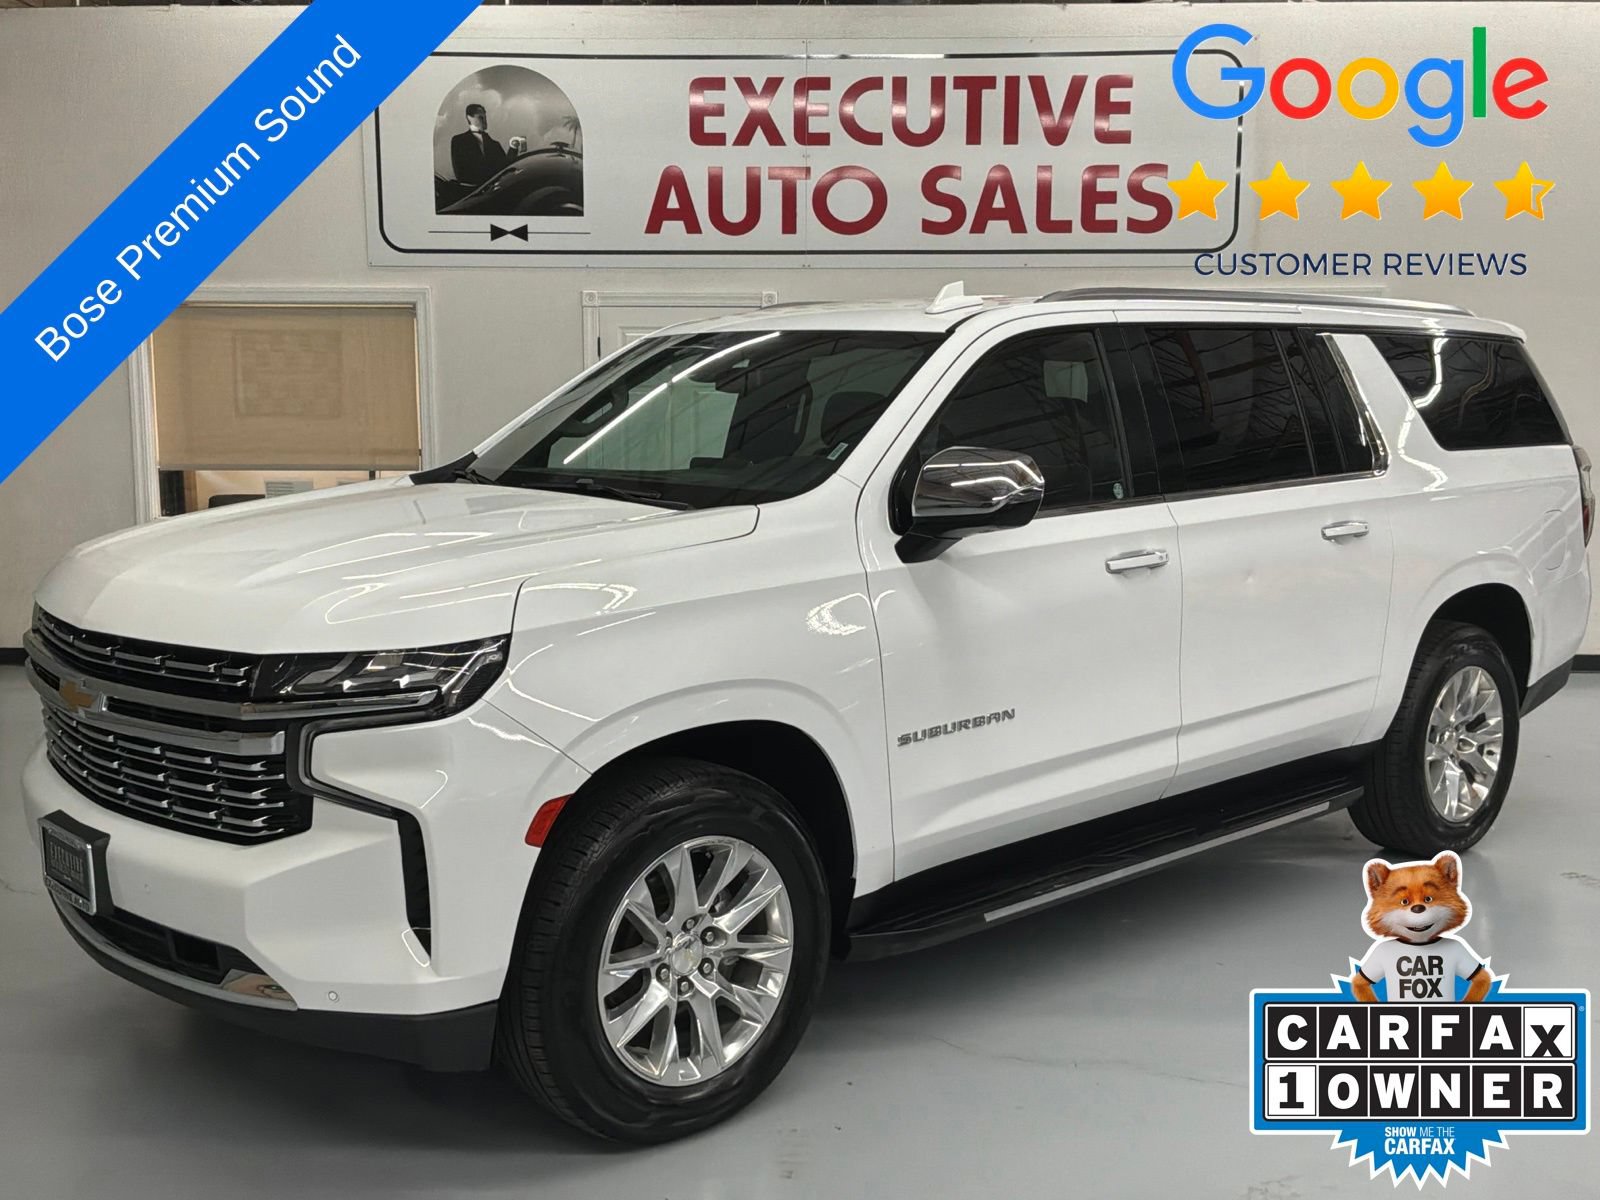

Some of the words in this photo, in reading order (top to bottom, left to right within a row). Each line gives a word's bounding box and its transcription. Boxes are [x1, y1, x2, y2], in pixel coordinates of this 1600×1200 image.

[689, 74, 1134, 147] EXECUTIVE
[645, 165, 888, 236] AUTO
[921, 163, 1173, 235] SALES
[897, 708, 1016, 747] SUBURBAN
